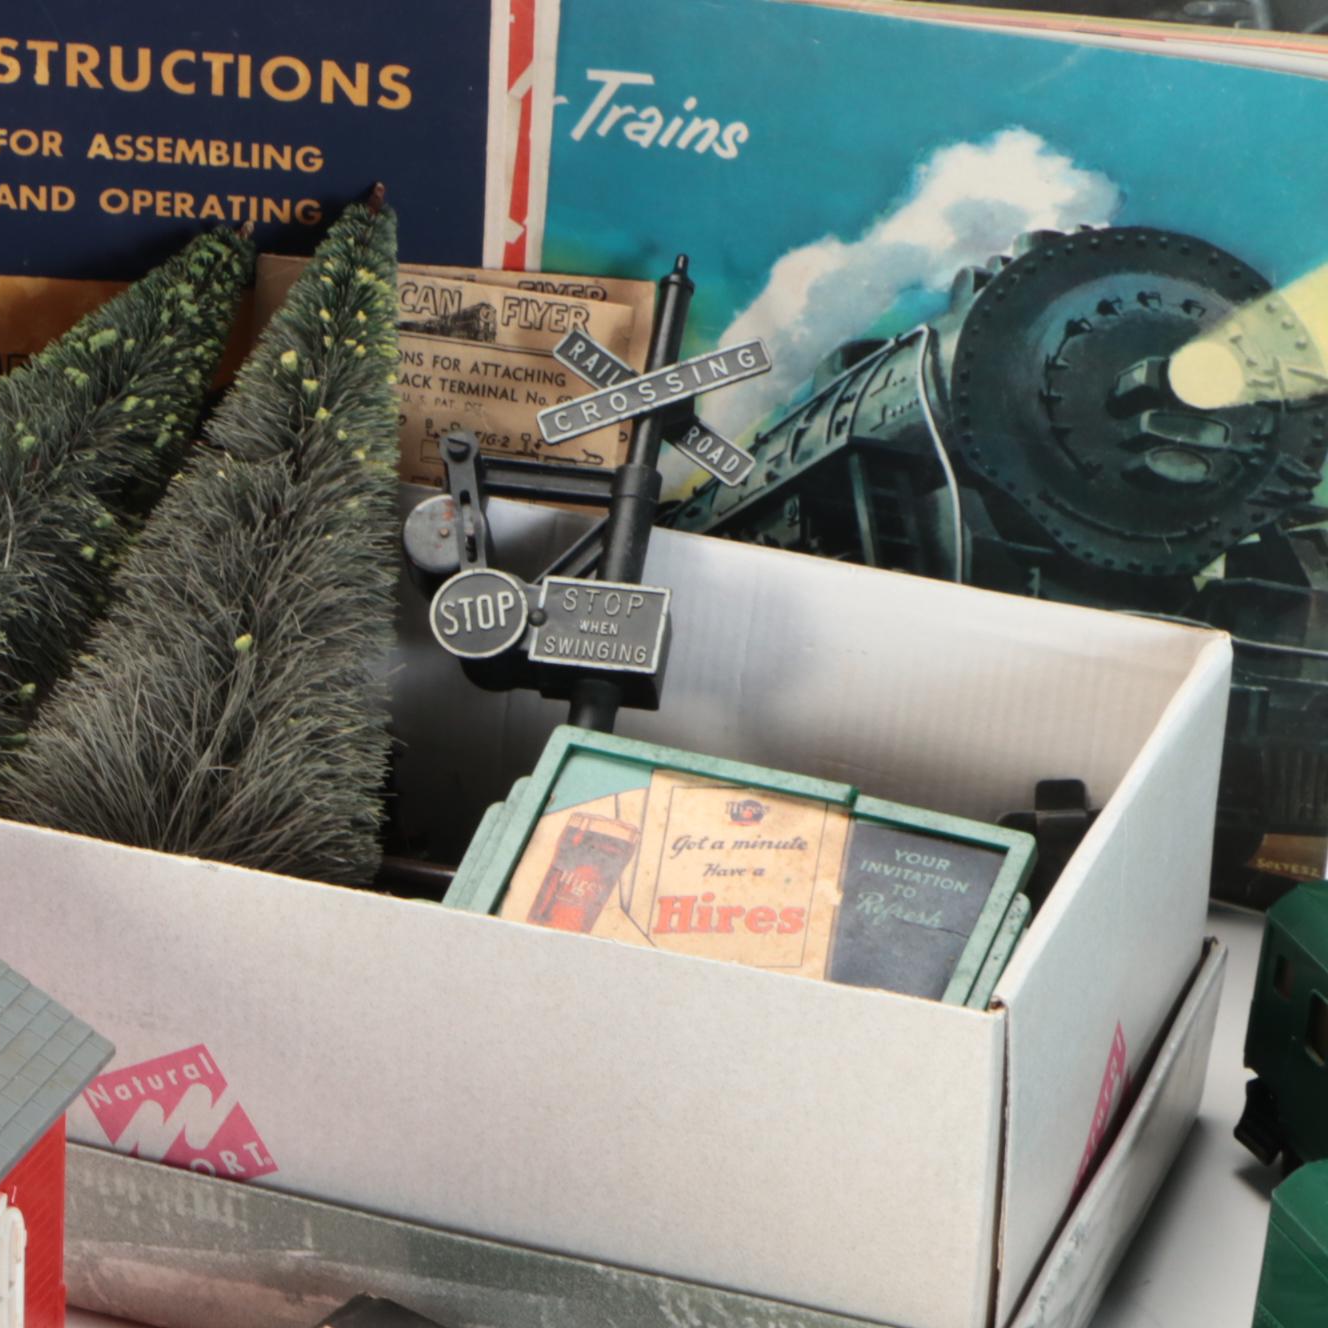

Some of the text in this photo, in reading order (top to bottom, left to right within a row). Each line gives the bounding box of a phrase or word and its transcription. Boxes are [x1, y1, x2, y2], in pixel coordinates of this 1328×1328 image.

[570, 68, 749, 159] Trains
[87, 133, 324, 173] ASSEMBLING
[99, 188, 323, 225] OPERATING
[399, 281, 590, 335] CAN FLYER
[432, 355, 461, 373] FOR
[469, 361, 566, 387] ATTACHING
[568, 340, 620, 387] RAIL
[398, 372, 432, 389] ACK
[439, 378, 519, 402] TERMINAL
[554, 349, 756, 431] CROSSING
[682, 425, 740, 473] ROAD
[440, 591, 515, 636] STOP
[563, 587, 644, 617] STOP
[578, 619, 619, 636] WHEN
[543, 635, 647, 665] SWINGING
[670, 834, 808, 859] Got a minute
[894, 849, 951, 871] YOUR
[703, 863, 765, 877] Have a
[860, 860, 970, 894] INVITATION
[856, 891, 944, 928] Refresh
[891, 884, 916, 898] TO
[652, 892, 806, 935] Hires
[85, 1052, 214, 1108] Natural
[190, 1141, 265, 1178] ORT
